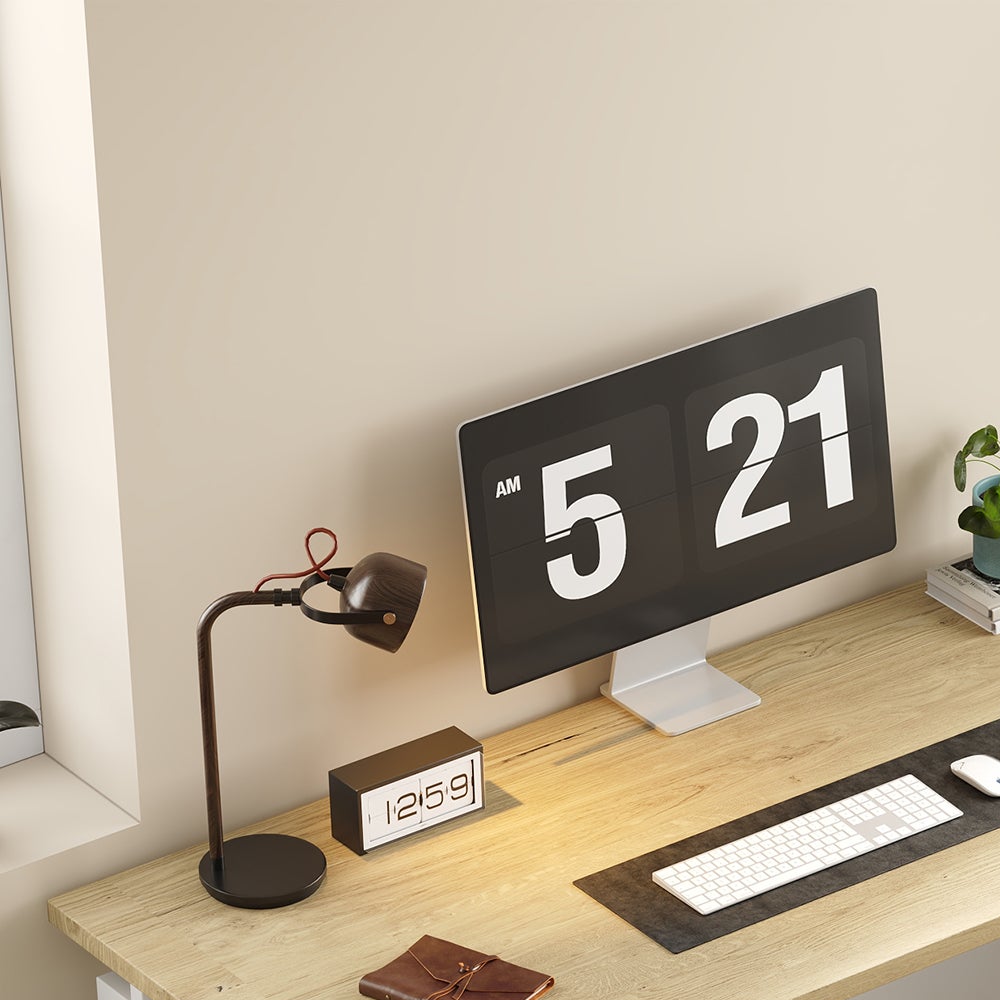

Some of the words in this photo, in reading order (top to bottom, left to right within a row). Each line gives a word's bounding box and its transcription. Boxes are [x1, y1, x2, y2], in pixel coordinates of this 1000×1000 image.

[495, 474, 521, 499] AM
[541, 444, 627, 600] 5
[705, 364, 854, 549] 21
